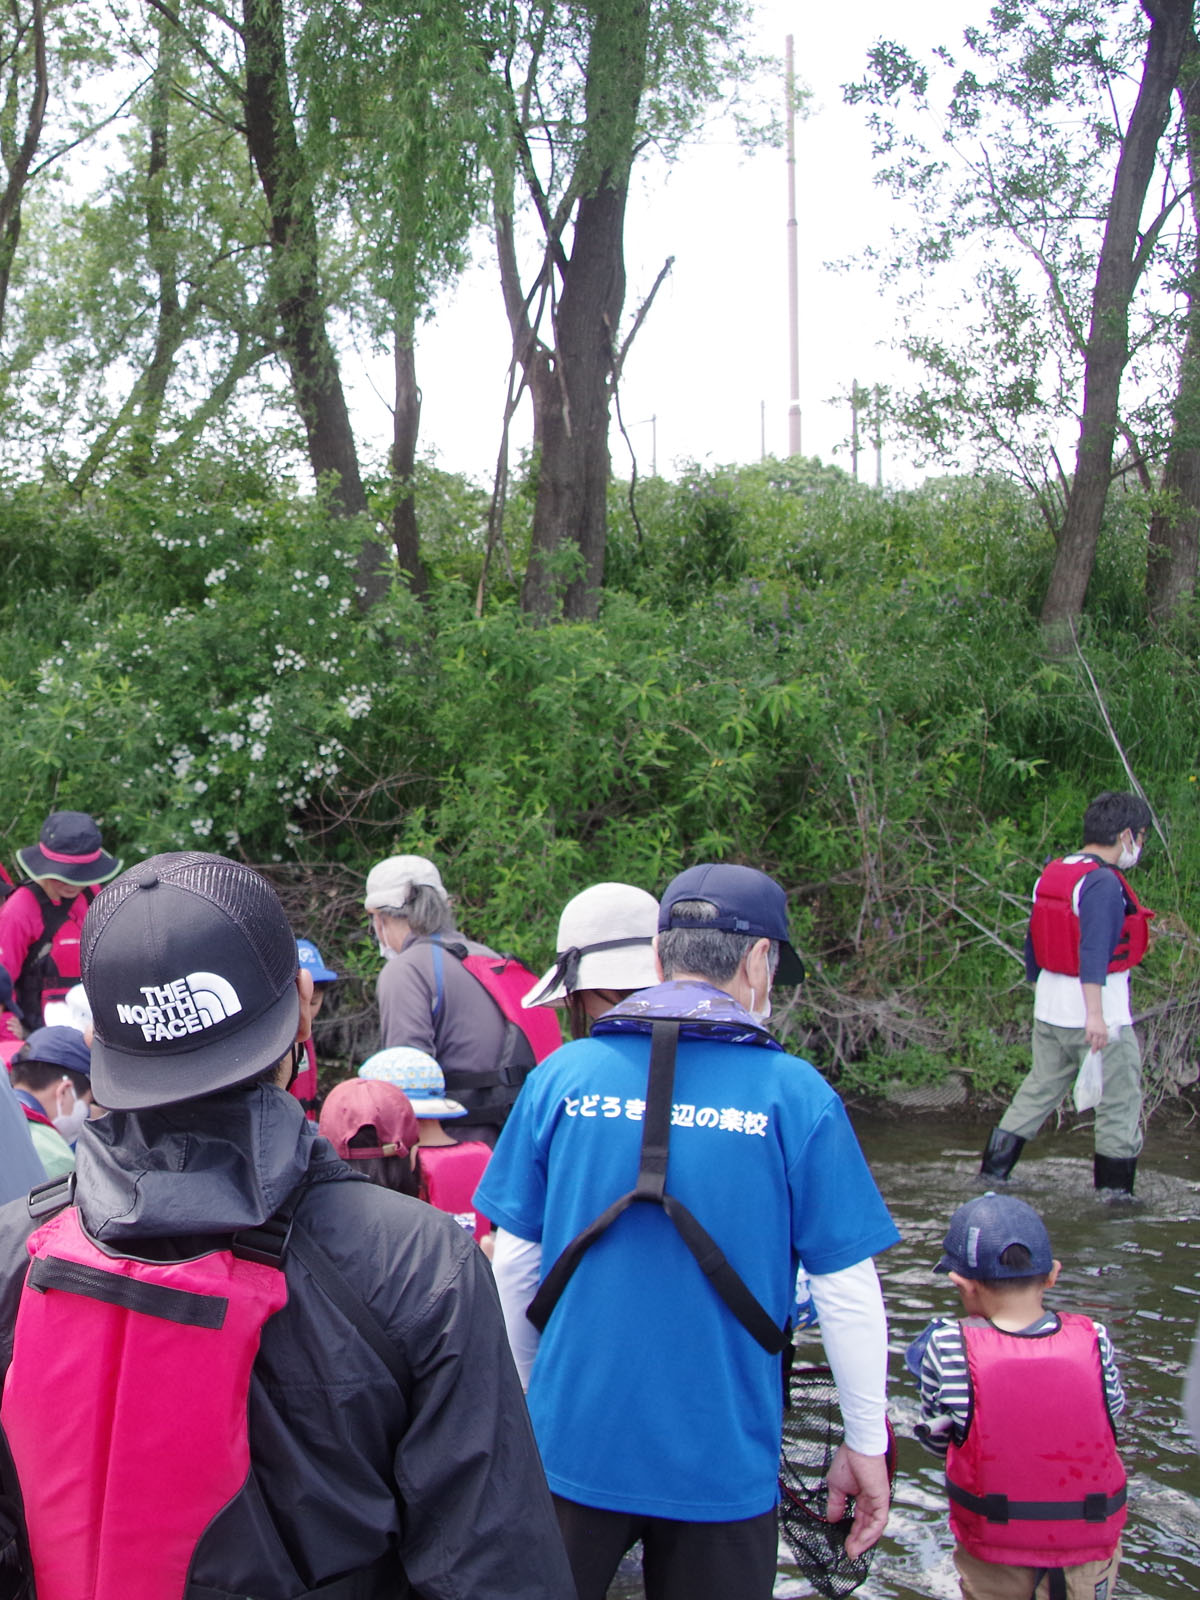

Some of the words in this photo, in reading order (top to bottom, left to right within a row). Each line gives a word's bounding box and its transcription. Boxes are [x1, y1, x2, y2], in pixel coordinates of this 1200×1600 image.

[140, 978, 191, 1006] THE
[116, 996, 197, 1025] NORTH
[141, 1013, 203, 1042] FACE
[564, 1095, 768, 1136] とどろき辺の楽校
